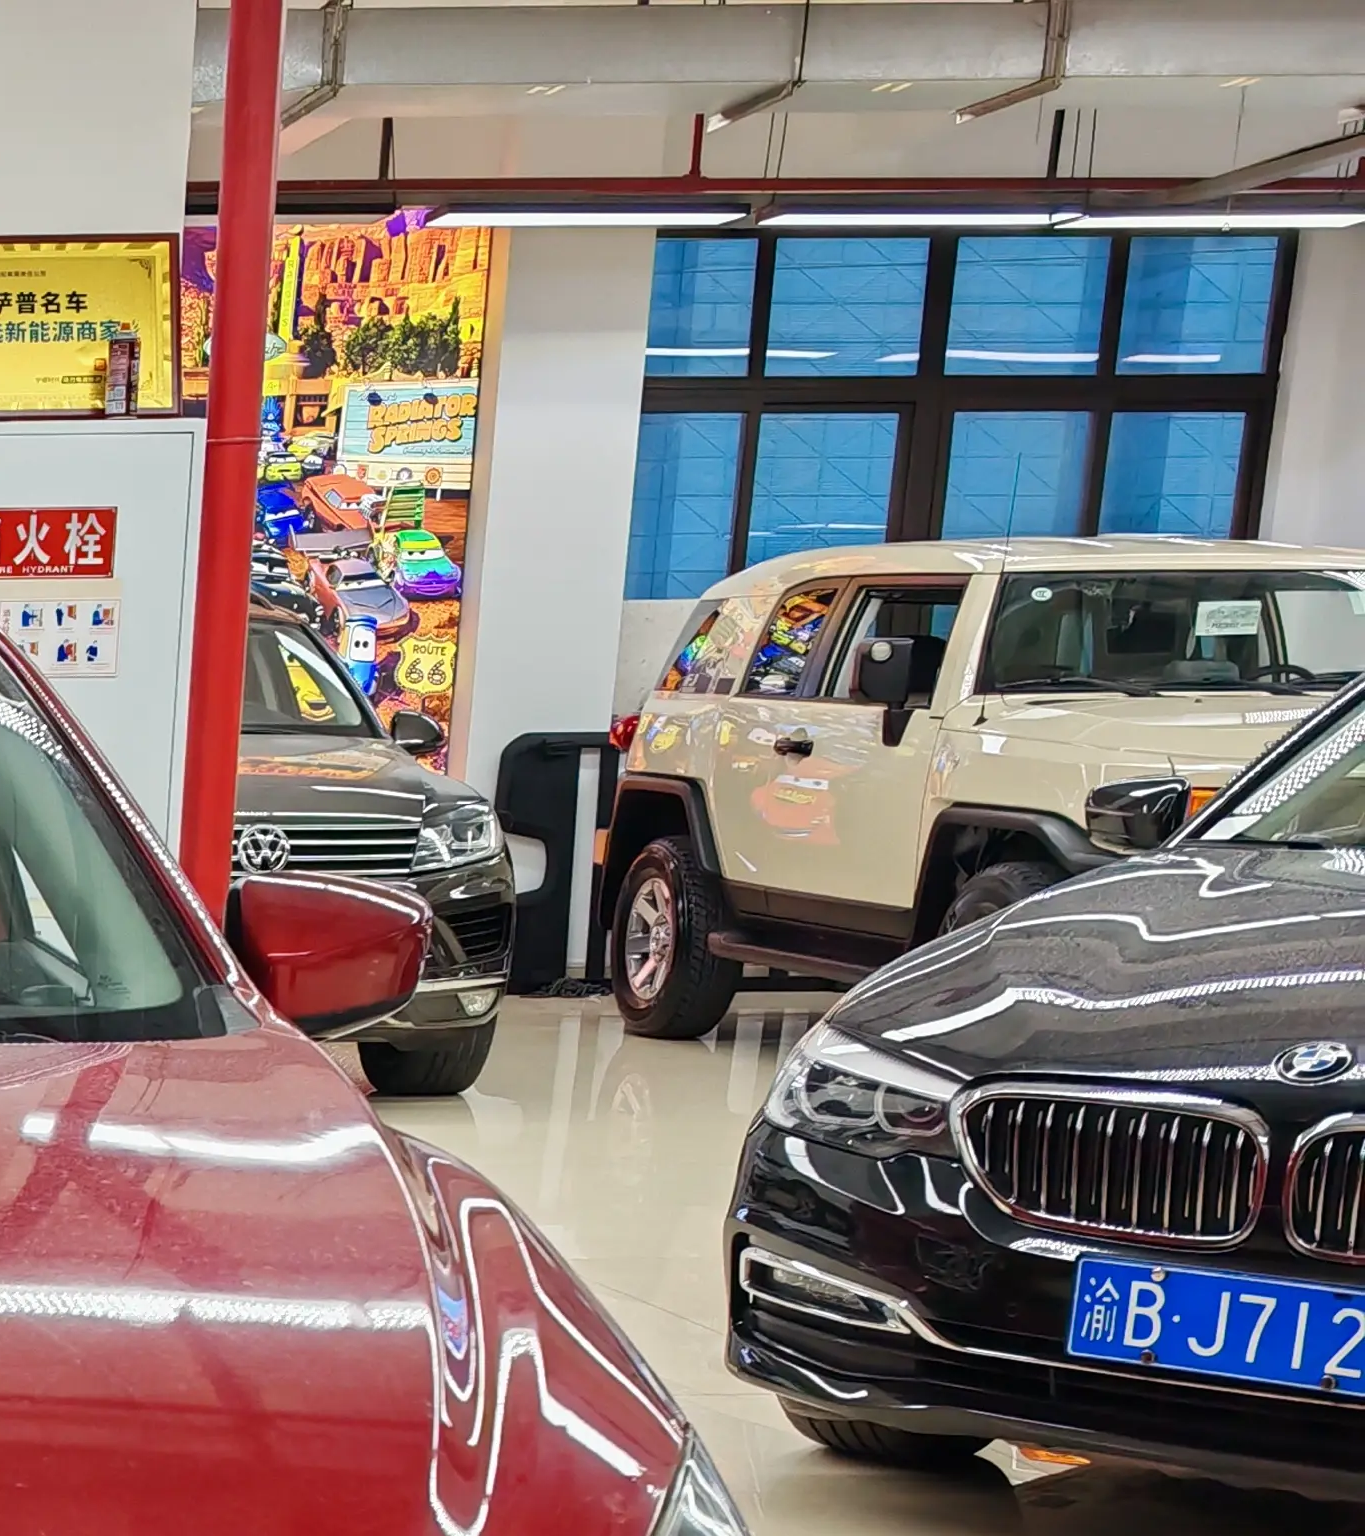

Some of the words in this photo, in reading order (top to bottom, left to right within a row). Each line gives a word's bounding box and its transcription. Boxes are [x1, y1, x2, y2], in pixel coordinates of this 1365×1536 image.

[367, 393, 477, 428] RADIATOR
[367, 417, 463, 453] SPRINGS
[21, 565, 75, 574] HYDRANT
[412, 643, 448, 656] ROUTE
[405, 657, 447, 686] 66
[1080, 1276, 1365, 1379] 渝B·J712
